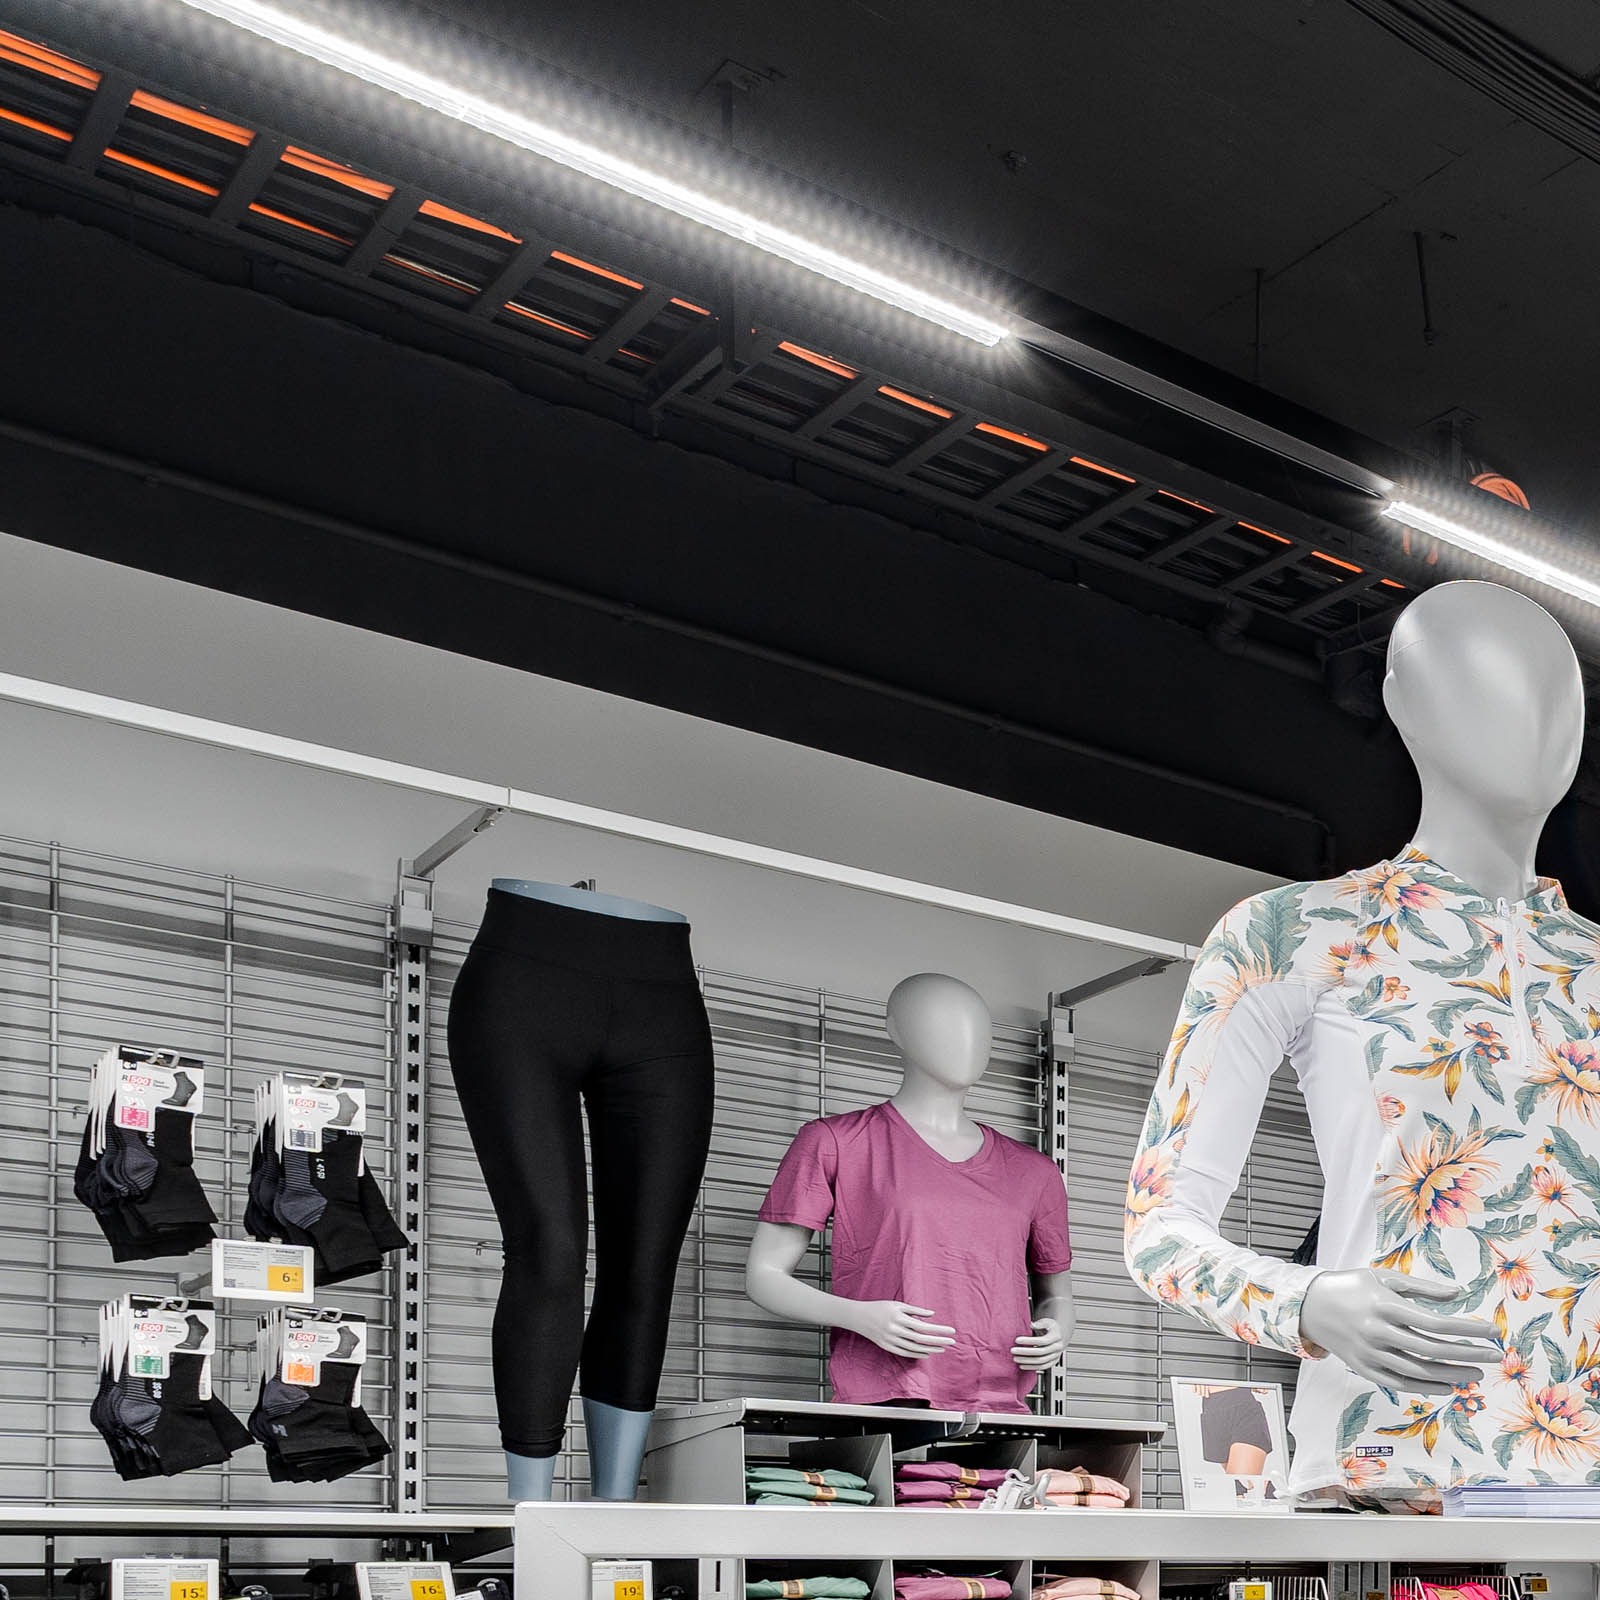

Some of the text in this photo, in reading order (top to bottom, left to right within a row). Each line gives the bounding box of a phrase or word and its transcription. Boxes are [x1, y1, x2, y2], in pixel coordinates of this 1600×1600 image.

[130, 1075, 150, 1086] 500
[295, 1099, 315, 1108] 500
[142, 1323, 162, 1332] 500
[296, 1333, 315, 1342] 500
[181, 1588, 199, 1599] 15
[420, 1585, 437, 1595] 16
[623, 1586, 637, 1597] 19
